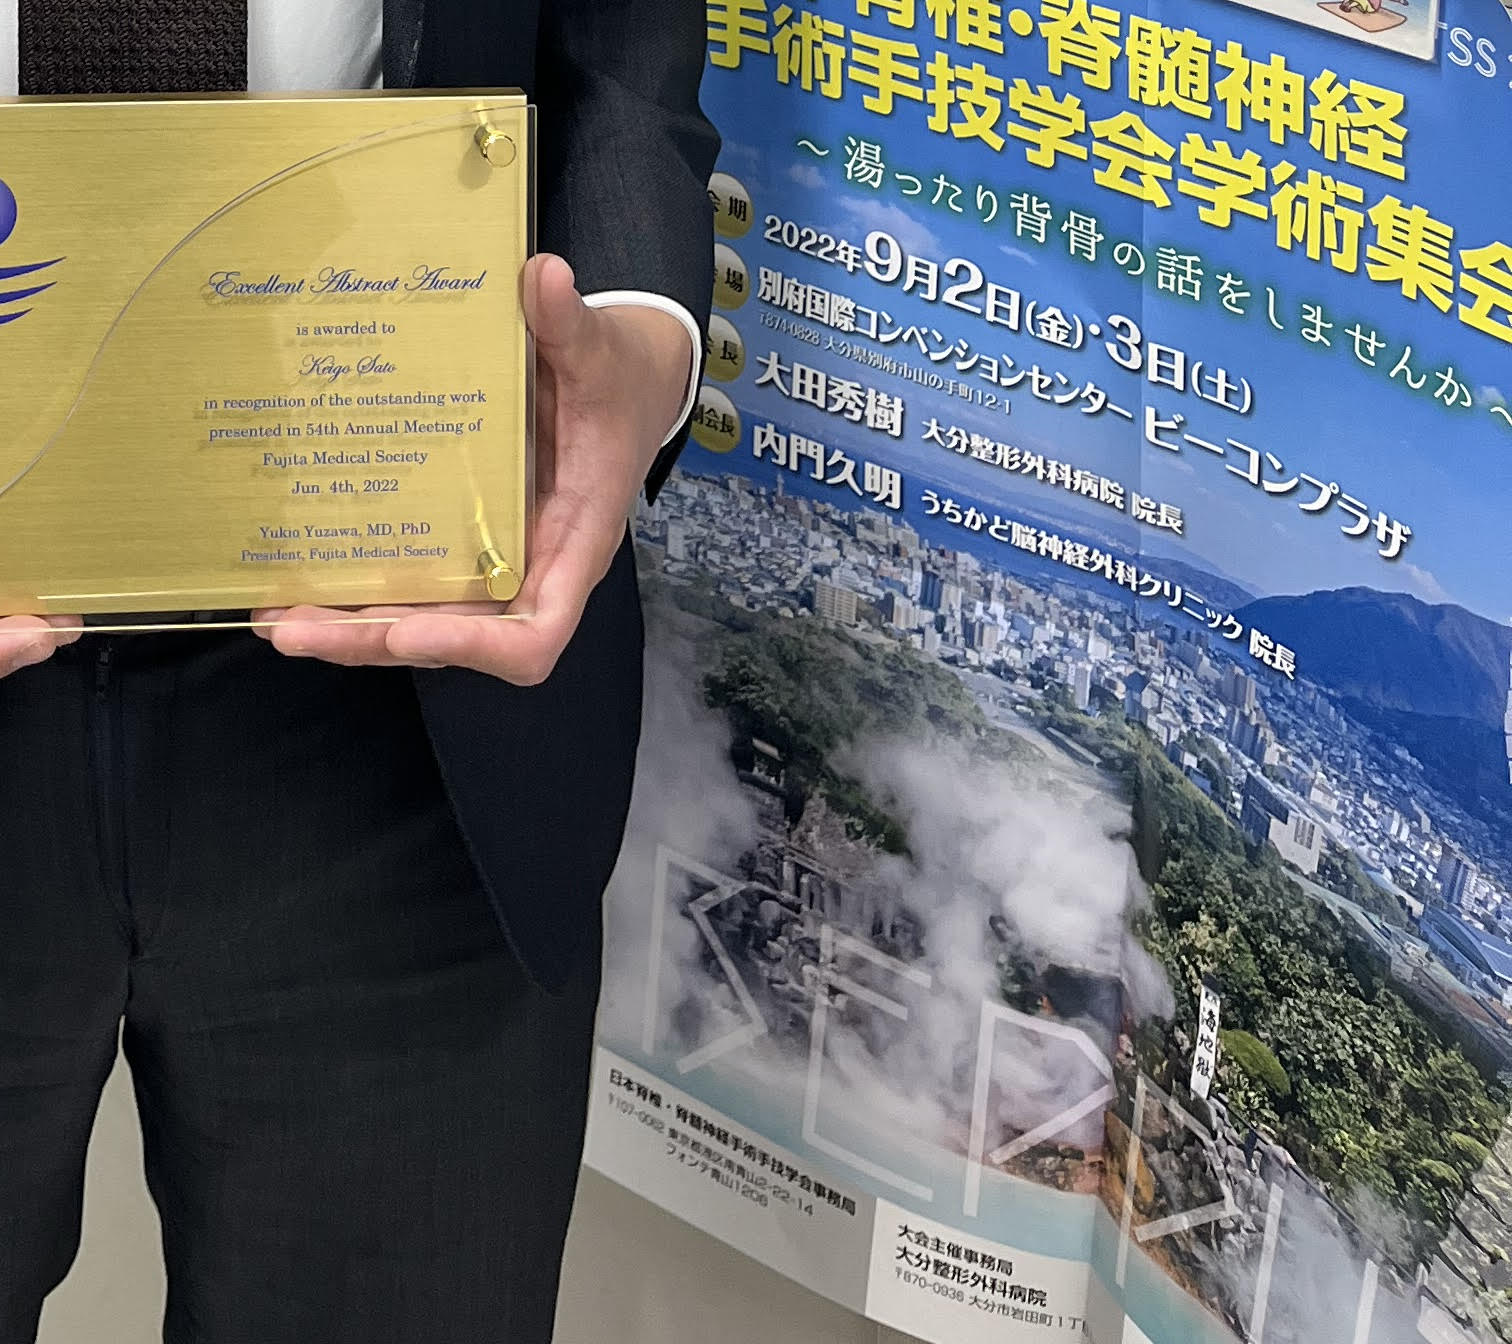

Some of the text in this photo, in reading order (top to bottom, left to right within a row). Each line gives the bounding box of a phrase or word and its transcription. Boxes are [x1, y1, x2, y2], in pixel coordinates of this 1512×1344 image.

[208, 263, 488, 298] Excellent Abstract Award
[296, 321, 396, 337] is awarded to
[298, 353, 398, 383] Keigo Sato
[203, 389, 487, 413] in recognition of the outstanding work
[757, 266, 1413, 558] 別府国際コンベンションセンター ビーコンプラザ
[209, 418, 484, 442] presented in 54th Annual Meeting of
[754, 351, 1185, 535] 大田秀樹 大分整形外科病院 院長
[263, 449, 429, 468] Fujita Medical Society
[329, 479, 399, 494] 4th, 2022
[259, 522, 431, 539] Yukio Yuzawa, MD, PhD
[241, 545, 449, 563] President, Fujita Medical Society
[753, 423, 1298, 681] 内門久明 うちかど脳神経外科クリニック 院長
[897, 1223, 1014, 1278] 大会主催事務局
[895, 1245, 1049, 1309] 大分整形外科病院
